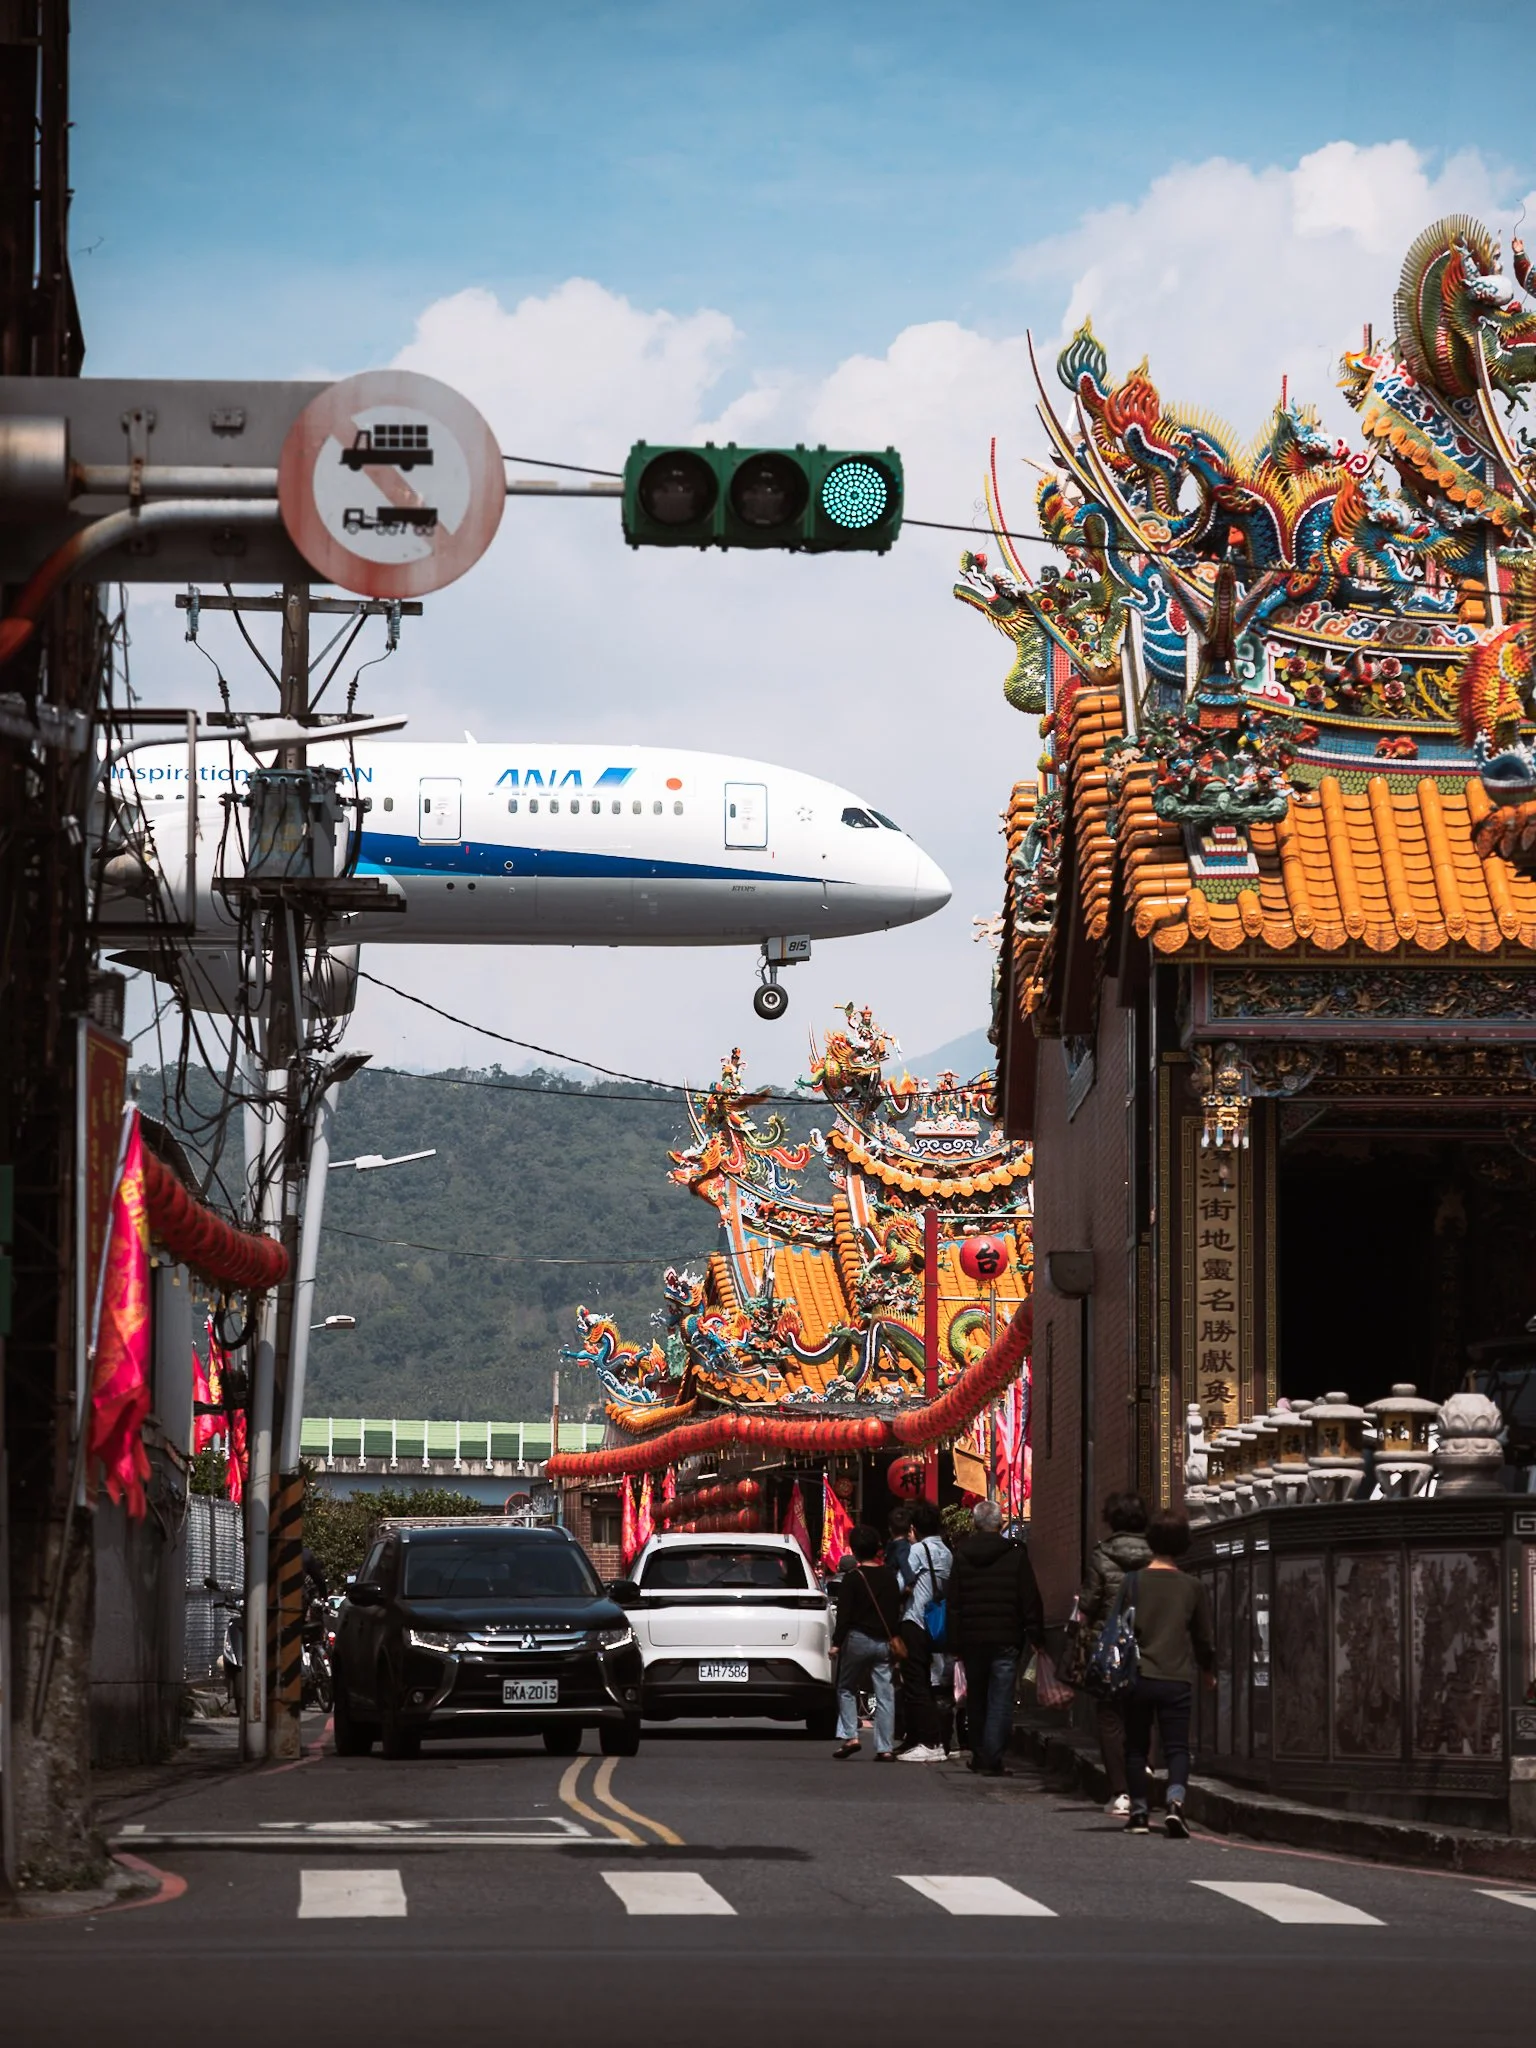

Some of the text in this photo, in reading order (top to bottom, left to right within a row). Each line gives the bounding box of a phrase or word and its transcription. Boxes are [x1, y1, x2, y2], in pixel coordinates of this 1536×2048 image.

[489, 768, 584, 796] ANA
[788, 940, 808, 952] 815
[975, 1242, 1000, 1274] 台
